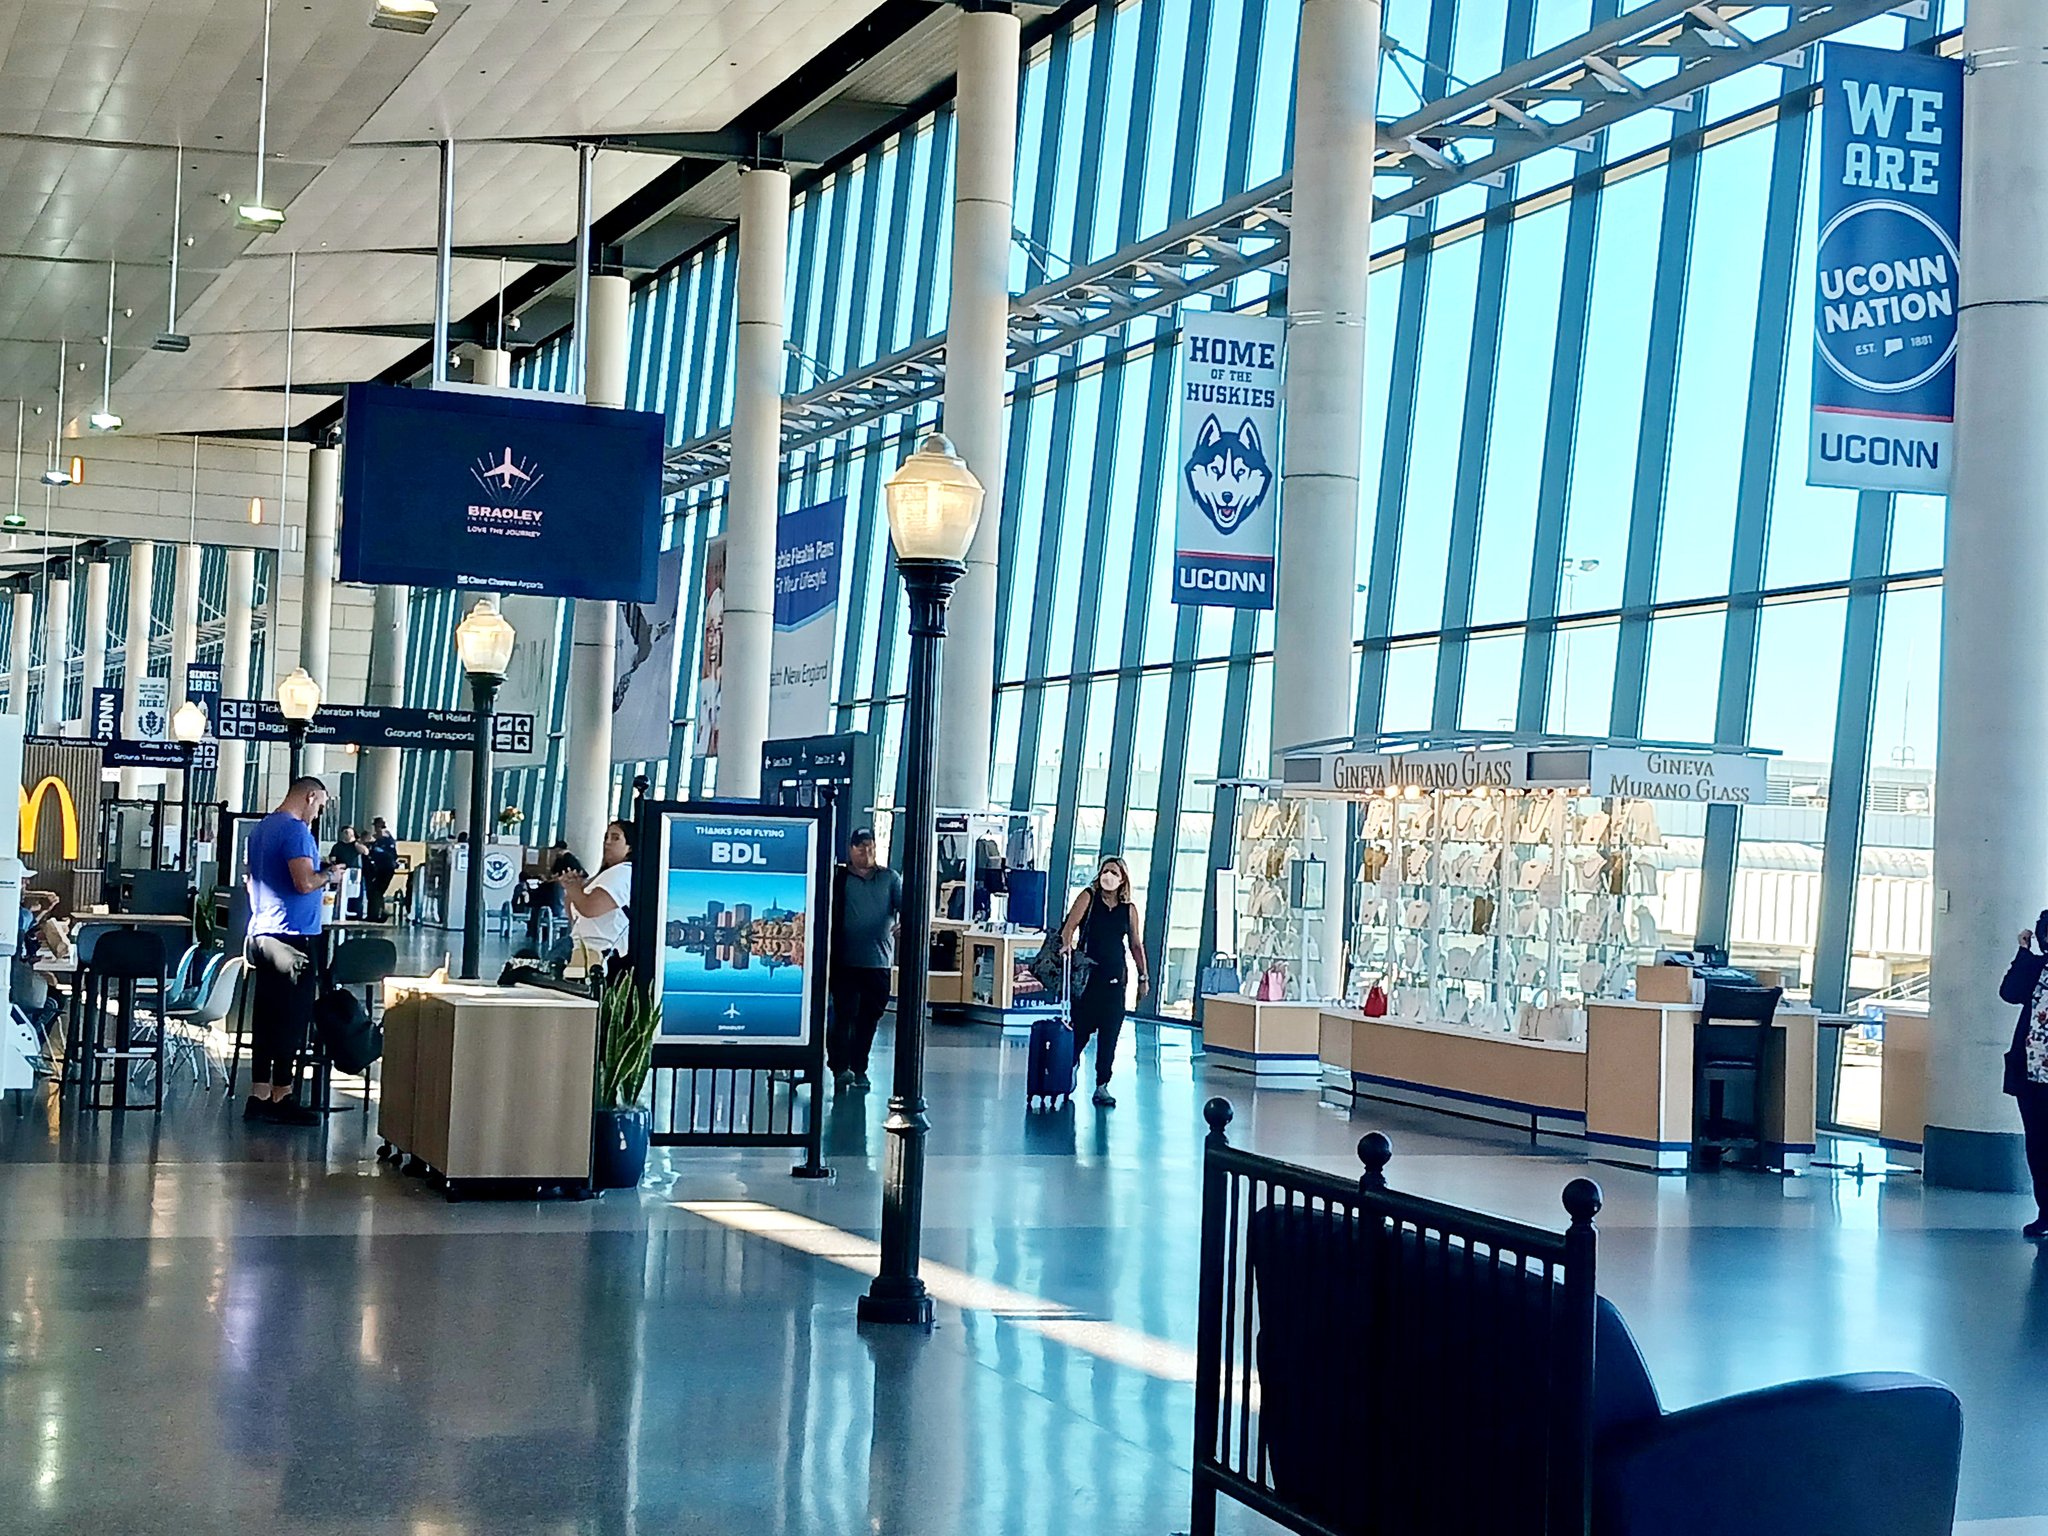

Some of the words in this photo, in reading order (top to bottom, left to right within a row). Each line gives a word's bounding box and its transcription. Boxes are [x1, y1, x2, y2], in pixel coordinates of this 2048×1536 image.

[1842, 79, 1944, 145] WE
[1842, 142, 1940, 195] ARE
[1819, 254, 1948, 301] UCONN
[1823, 287, 1953, 334] NATION
[1189, 336, 1276, 370] HOME
[1210, 367, 1226, 382] OF
[1229, 370, 1253, 383] THE
[1186, 382, 1276, 409] HUSKIES
[1820, 432, 1939, 470] UCONN
[468, 505, 543, 522] BRADLEY
[467, 525, 487, 534] LOVE
[489, 527, 505, 536] THE
[505, 529, 541, 538] JOURNEY
[815, 540, 835, 561] Plans
[1179, 567, 1267, 593] UCONN
[188, 669, 220, 680] SINCE
[783, 665, 801, 686] New
[802, 659, 829, 688] England
[188, 680, 220, 692] 1881
[139, 699, 165, 708] HERE
[356, 708, 381, 719] Hotel
[427, 711, 443, 722] Pet
[446, 712, 471, 723] Relief
[308, 723, 336, 735] Claim
[384, 727, 422, 739] Ground
[1389, 754, 1458, 789] MURANO
[1461, 751, 1513, 789] GLASS
[1608, 774, 1692, 799] MURANO
[1695, 778, 1750, 803] GLASS
[695, 826, 733, 836] THANKS
[733, 828, 753, 837] FOR
[753, 829, 785, 838] FLYING
[711, 841, 768, 865] BDL
